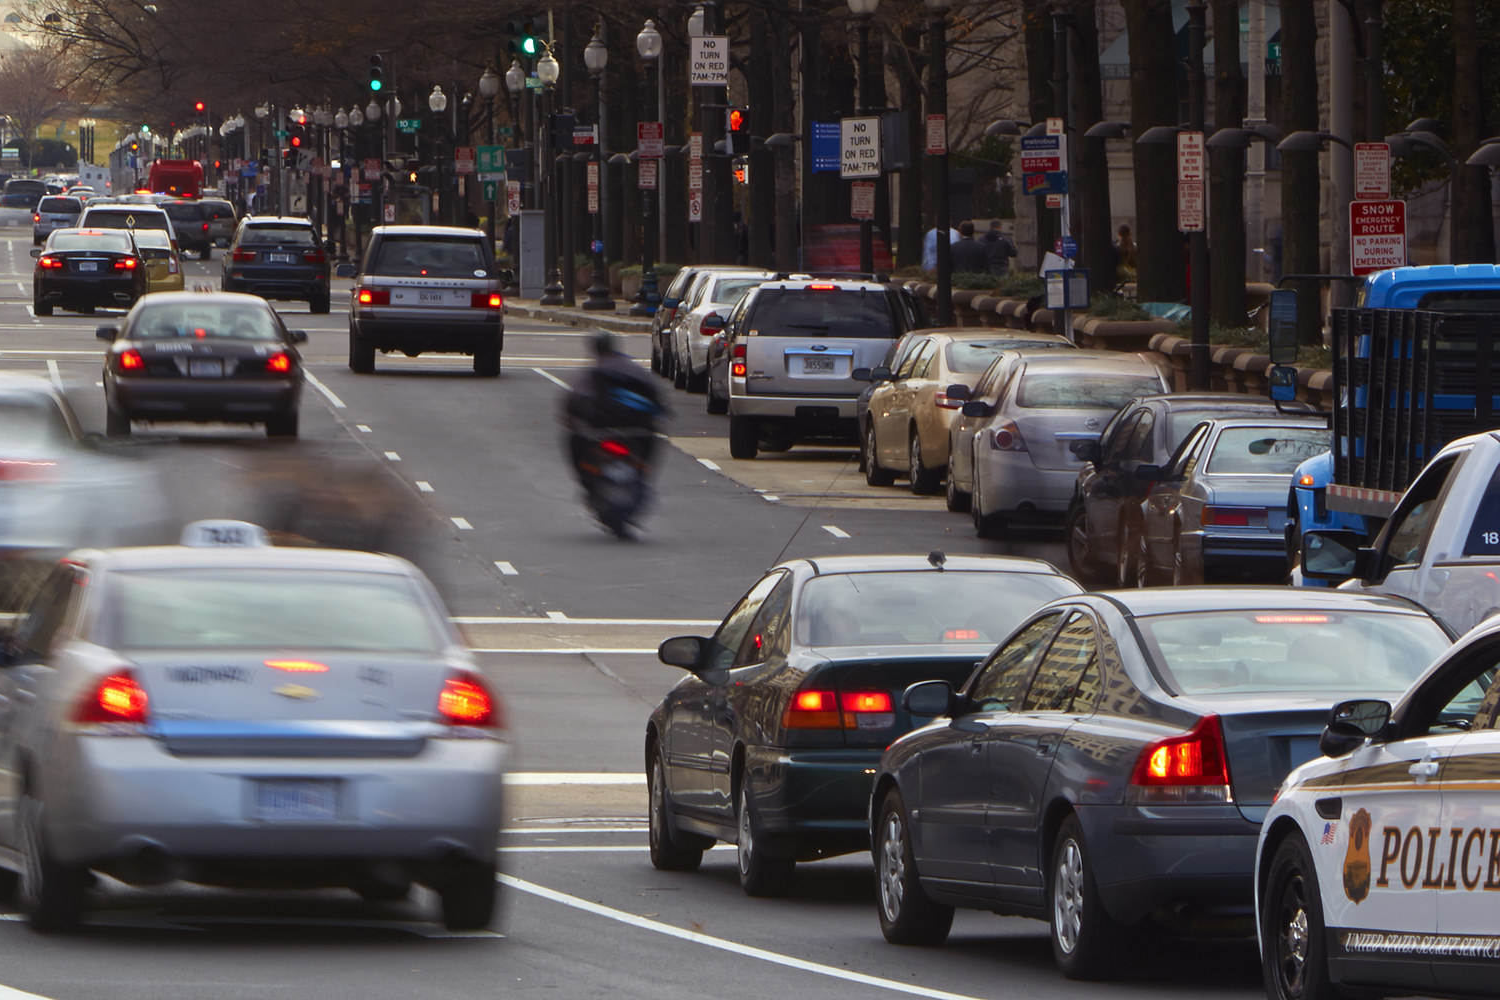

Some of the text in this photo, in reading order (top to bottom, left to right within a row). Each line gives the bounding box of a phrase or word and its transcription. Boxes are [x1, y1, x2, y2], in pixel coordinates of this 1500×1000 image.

[703, 40, 716, 48] NO
[700, 51, 720, 59] TURN
[694, 62, 725, 70] ON RED
[692, 72, 728, 80] 7AM-7PM
[854, 124, 867, 133] NO
[850, 136, 871, 146] TURN
[845, 149, 875, 159] ON RED
[843, 162, 879, 172] 7AM-7PM
[1362, 205, 1394, 214] SNOW
[1356, 216, 1400, 224] EMERGENCY
[1362, 225, 1395, 233] ROUTE
[1356, 237, 1401, 246] NO PARKING
[1364, 247, 1394, 255] DURING
[1356, 257, 1402, 266] EMERGENCY
[1345, 933, 1384, 952] UNITED
[1381, 934, 1421, 954] STATES
[1416, 936, 1460, 955] SECRET
